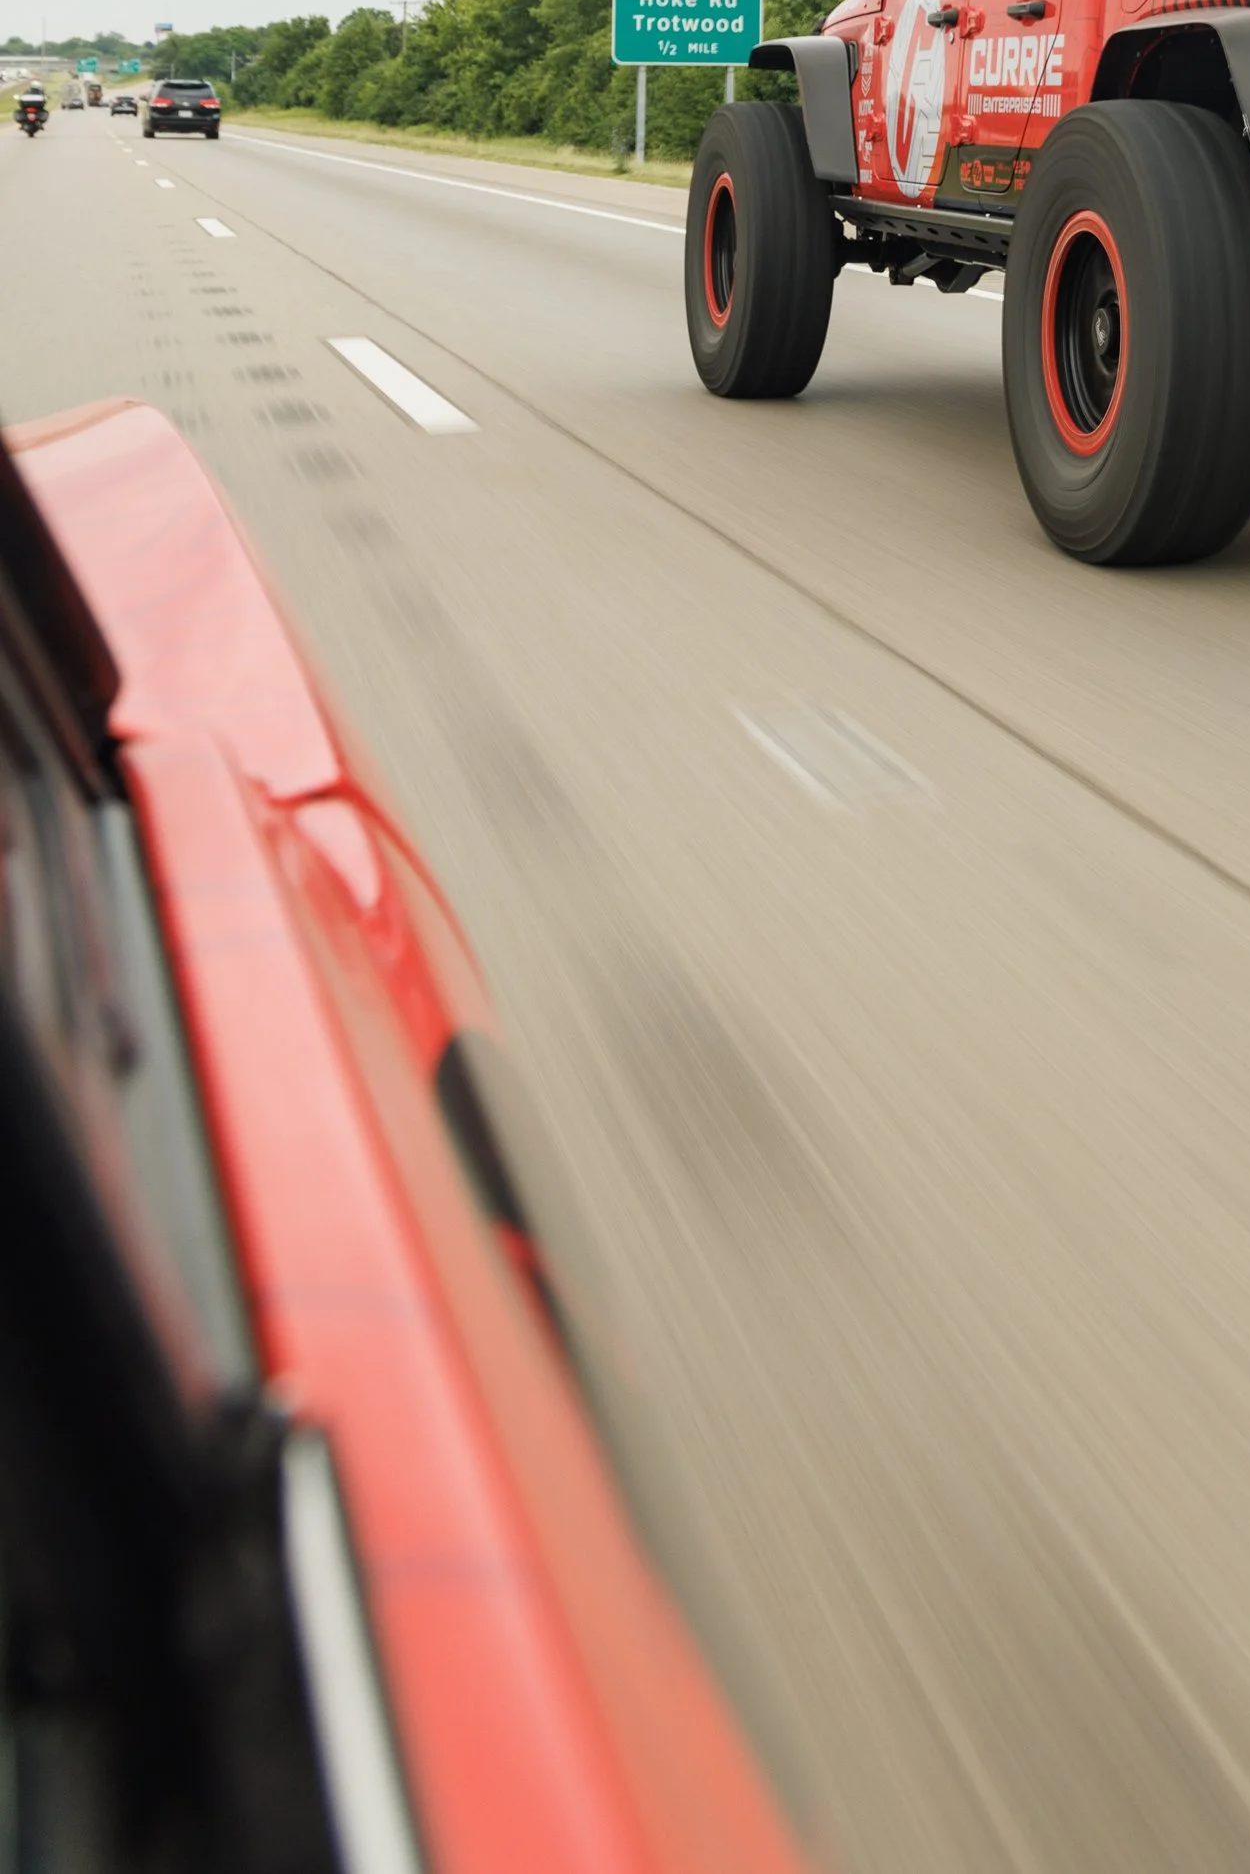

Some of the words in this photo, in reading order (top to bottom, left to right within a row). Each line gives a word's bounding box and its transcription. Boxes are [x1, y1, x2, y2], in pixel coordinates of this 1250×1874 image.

[632, 14, 744, 33] Trotwood
[688, 42, 719, 55] MILE
[969, 34, 1065, 86] CURRIE
[982, 96, 1042, 114] ENTERPRISES
